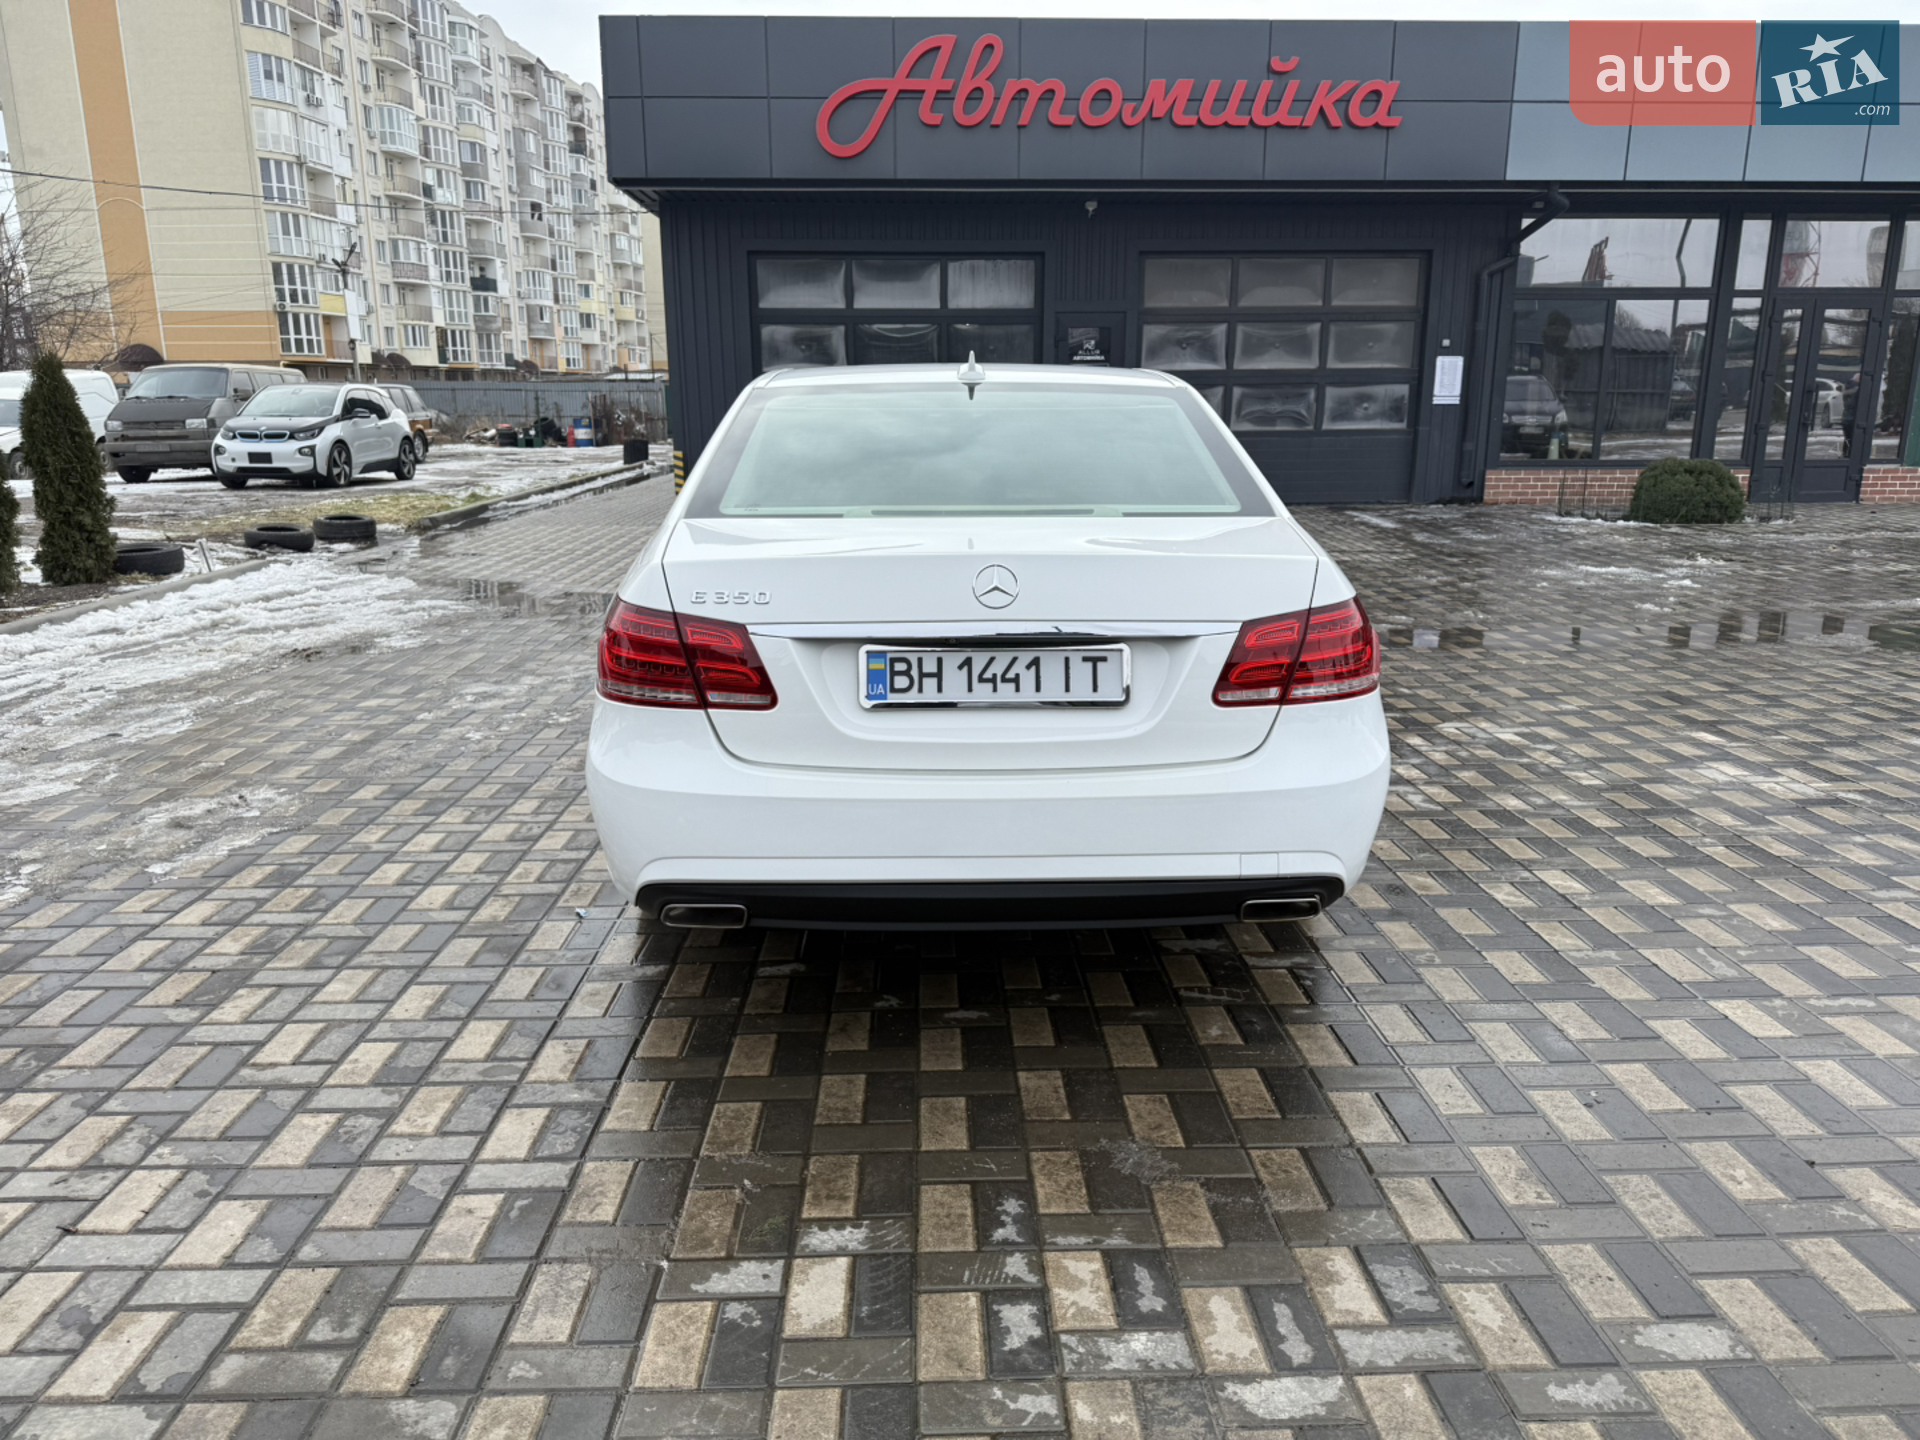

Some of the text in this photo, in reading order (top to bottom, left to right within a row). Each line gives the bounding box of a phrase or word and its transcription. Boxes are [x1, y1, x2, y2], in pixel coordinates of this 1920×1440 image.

[816, 34, 1402, 158] Автомийка
[691, 590, 772, 605] E 350
[888, 655, 1108, 693] BH 1441 IT
[868, 683, 885, 695] UA
